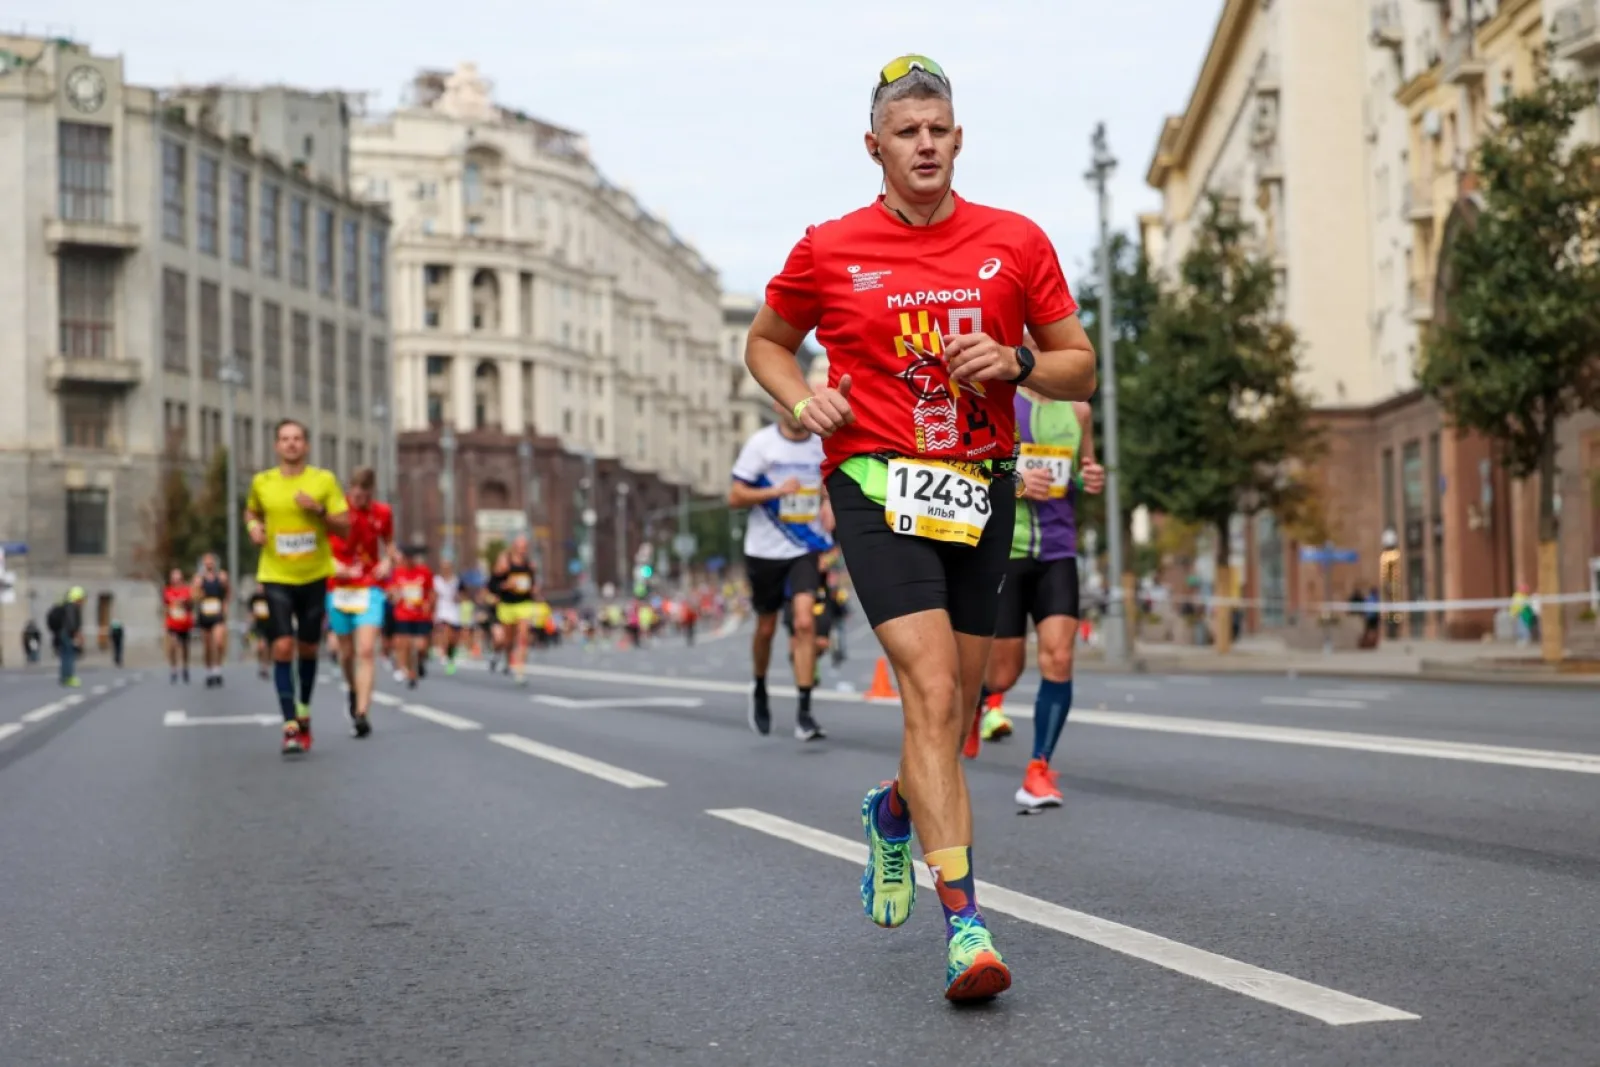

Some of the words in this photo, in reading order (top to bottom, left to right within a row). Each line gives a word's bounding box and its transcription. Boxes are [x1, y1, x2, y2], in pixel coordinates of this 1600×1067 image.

[887, 288, 981, 309] МАРАФОН
[895, 467, 990, 515] 12433
[927, 506, 956, 519] ИЛЬЯ
[899, 514, 913, 532] D
